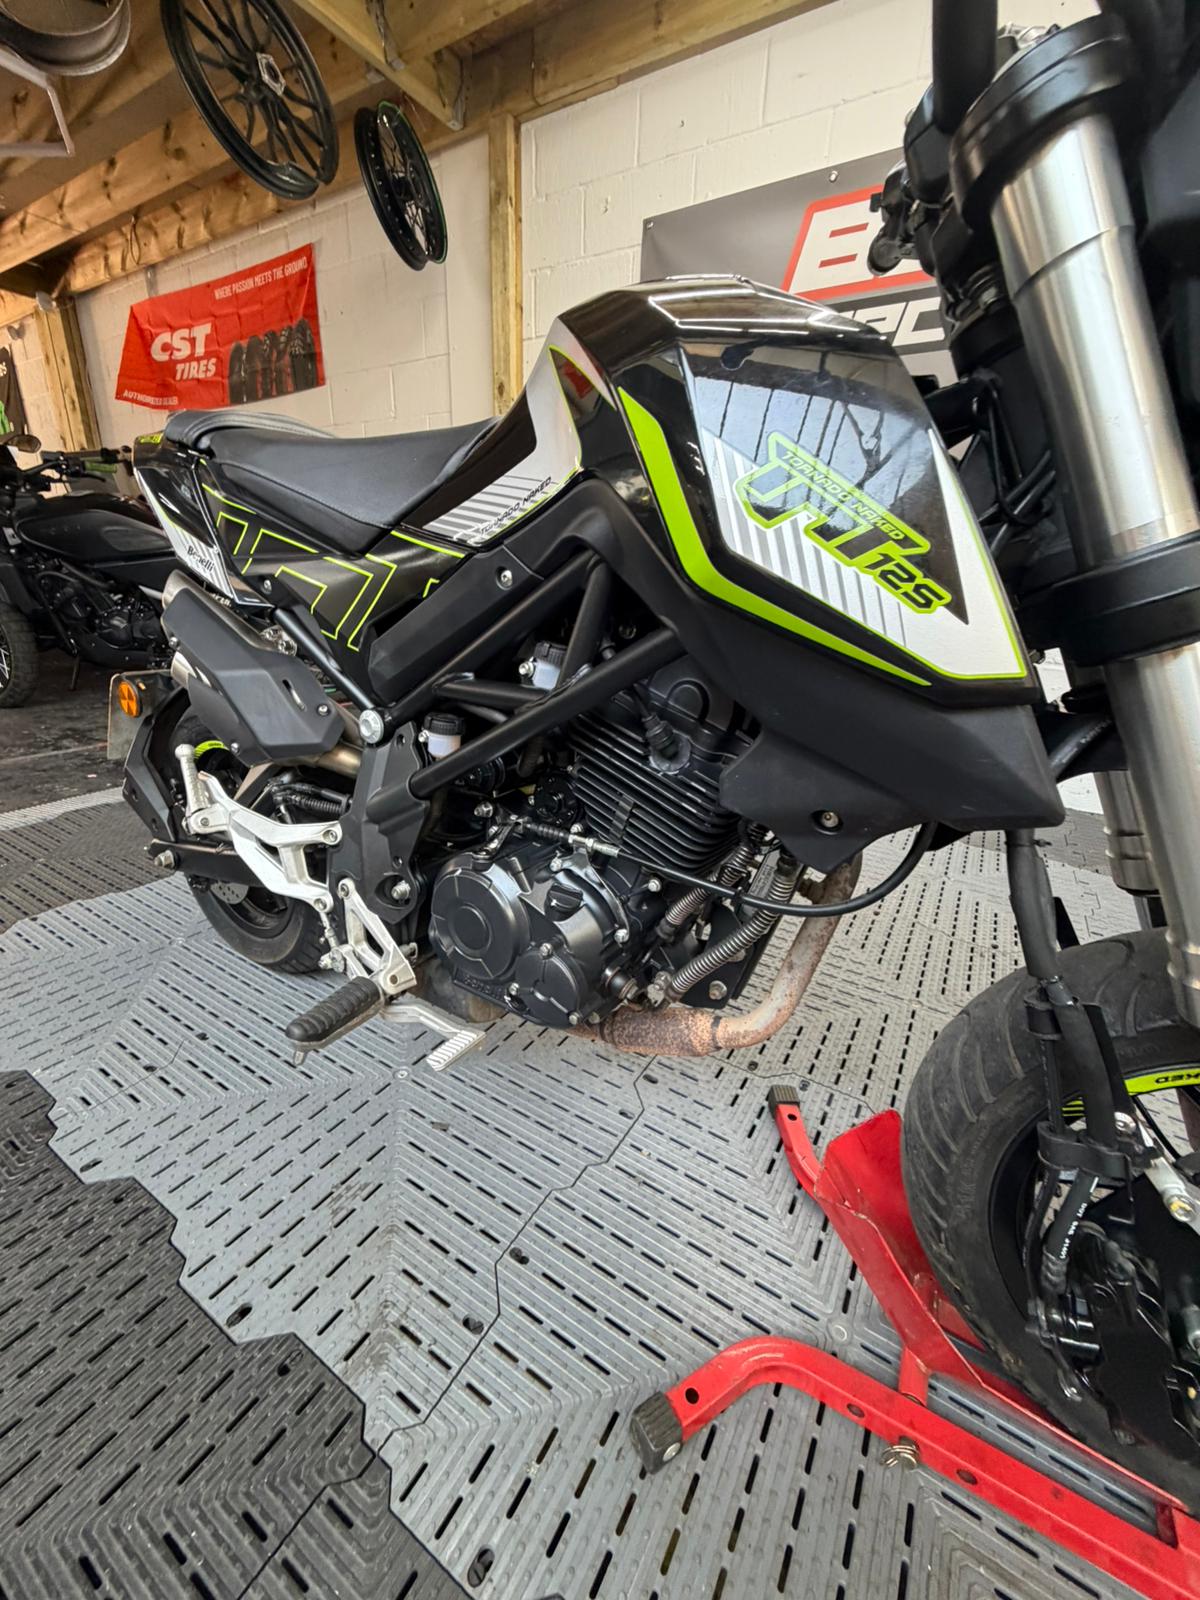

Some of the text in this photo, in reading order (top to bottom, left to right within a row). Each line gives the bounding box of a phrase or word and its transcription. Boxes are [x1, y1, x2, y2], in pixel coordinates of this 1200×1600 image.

[214, 256, 308, 300] WHERE PASSION MEETS THE GROUND
[151, 323, 212, 362] CST
[175, 358, 216, 381] TIRES
[522, 476, 552, 505] NAKED
[782, 452, 905, 540] TORNADO NAKED
[864, 553, 945, 609] 125
